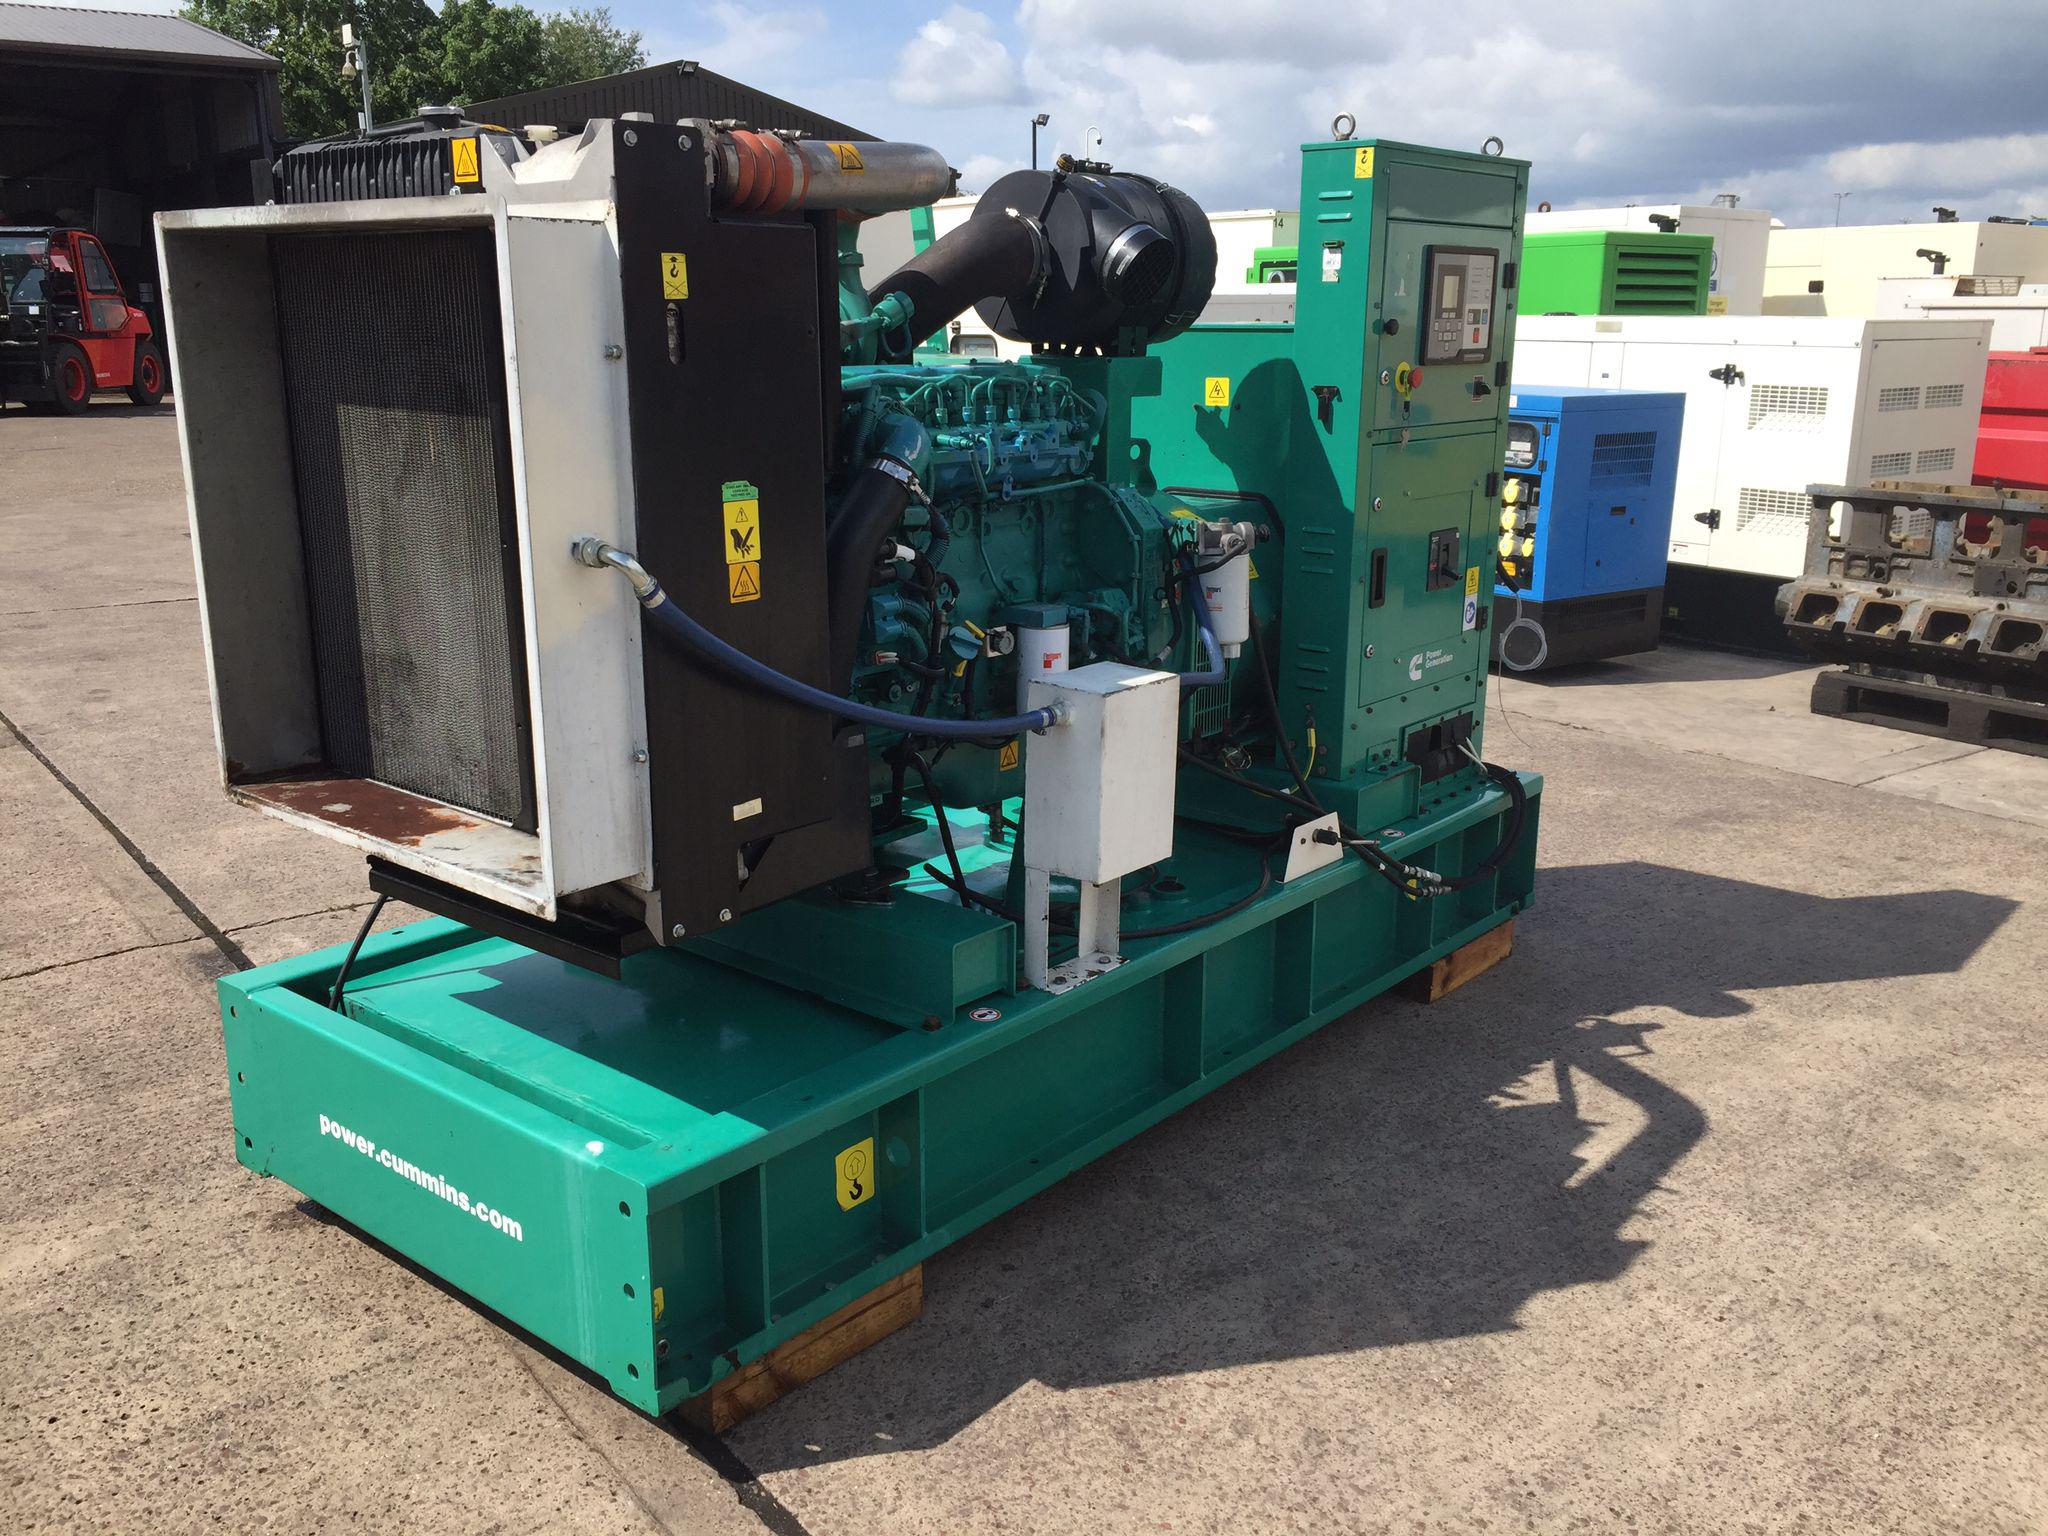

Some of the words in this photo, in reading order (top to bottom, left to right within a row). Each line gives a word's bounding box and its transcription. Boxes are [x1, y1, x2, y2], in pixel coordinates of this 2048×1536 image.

[1273, 217, 1284, 229] 14
[1426, 649, 1442, 659] Power
[1425, 654, 1453, 668] Generation
[318, 1112, 524, 1243] power.cummins.com
